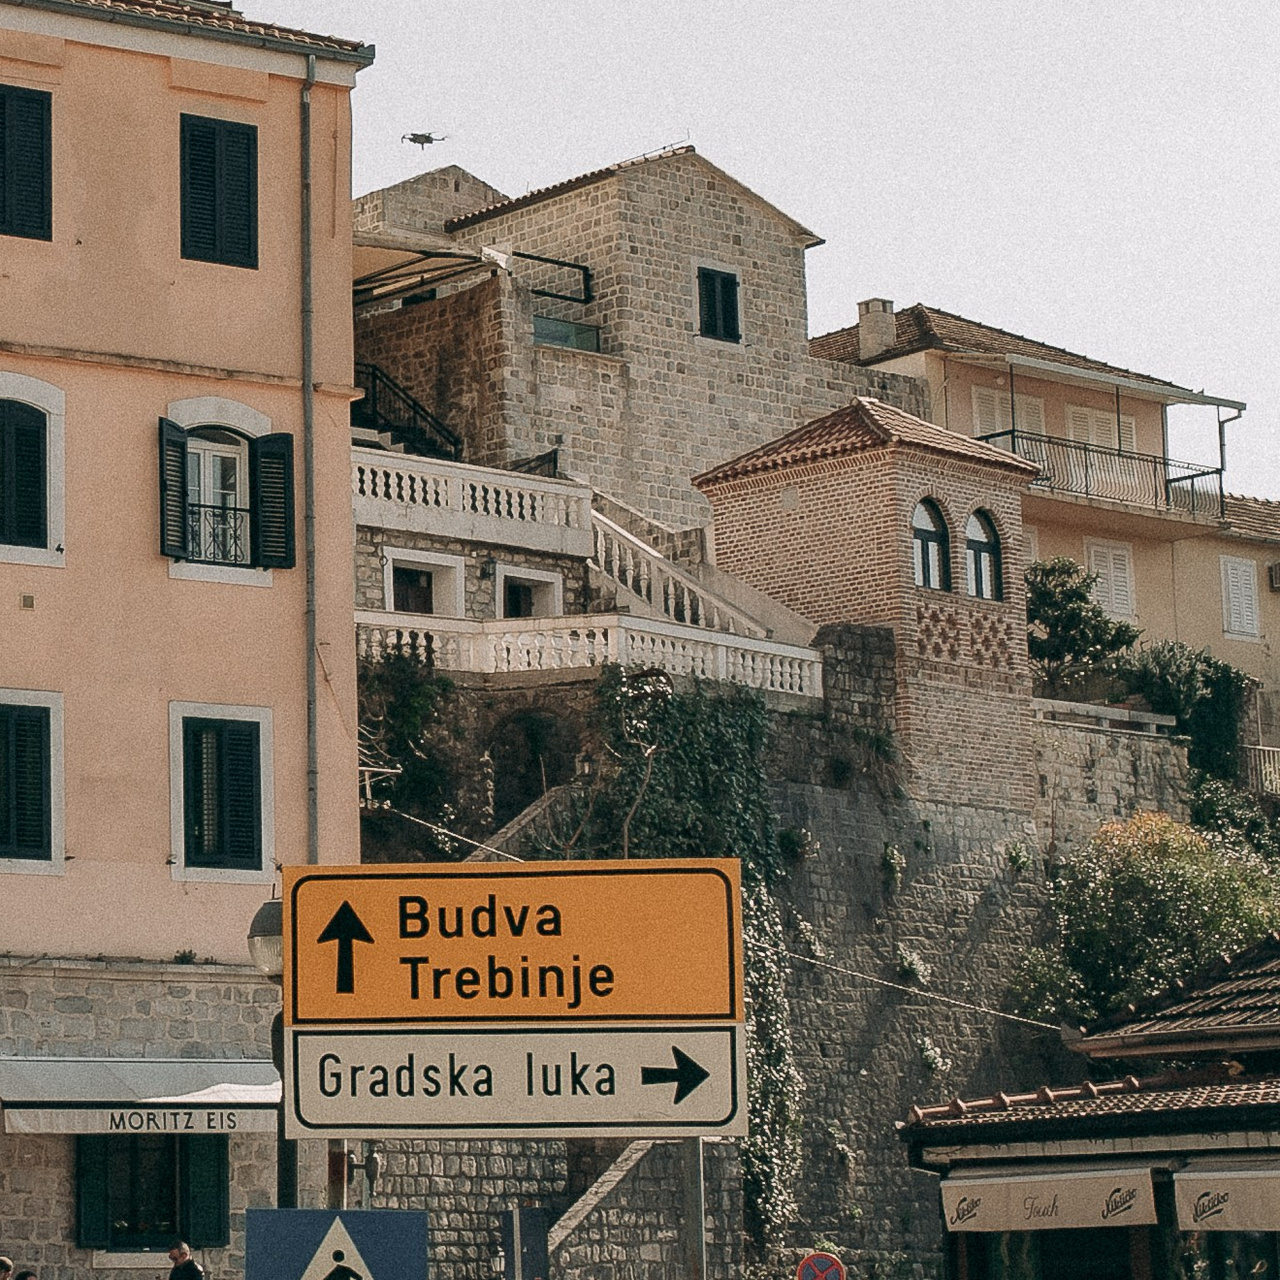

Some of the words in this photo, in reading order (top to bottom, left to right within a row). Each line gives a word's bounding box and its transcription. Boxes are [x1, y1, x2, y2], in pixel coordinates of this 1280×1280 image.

[399, 894, 562, 939] Budva
[399, 955, 615, 1009] Trebinje
[319, 1053, 494, 1098] Gradska
[526, 1052, 616, 1097] luka
[110, 1111, 195, 1130] MORITZ
[207, 1111, 237, 1130] EIS
